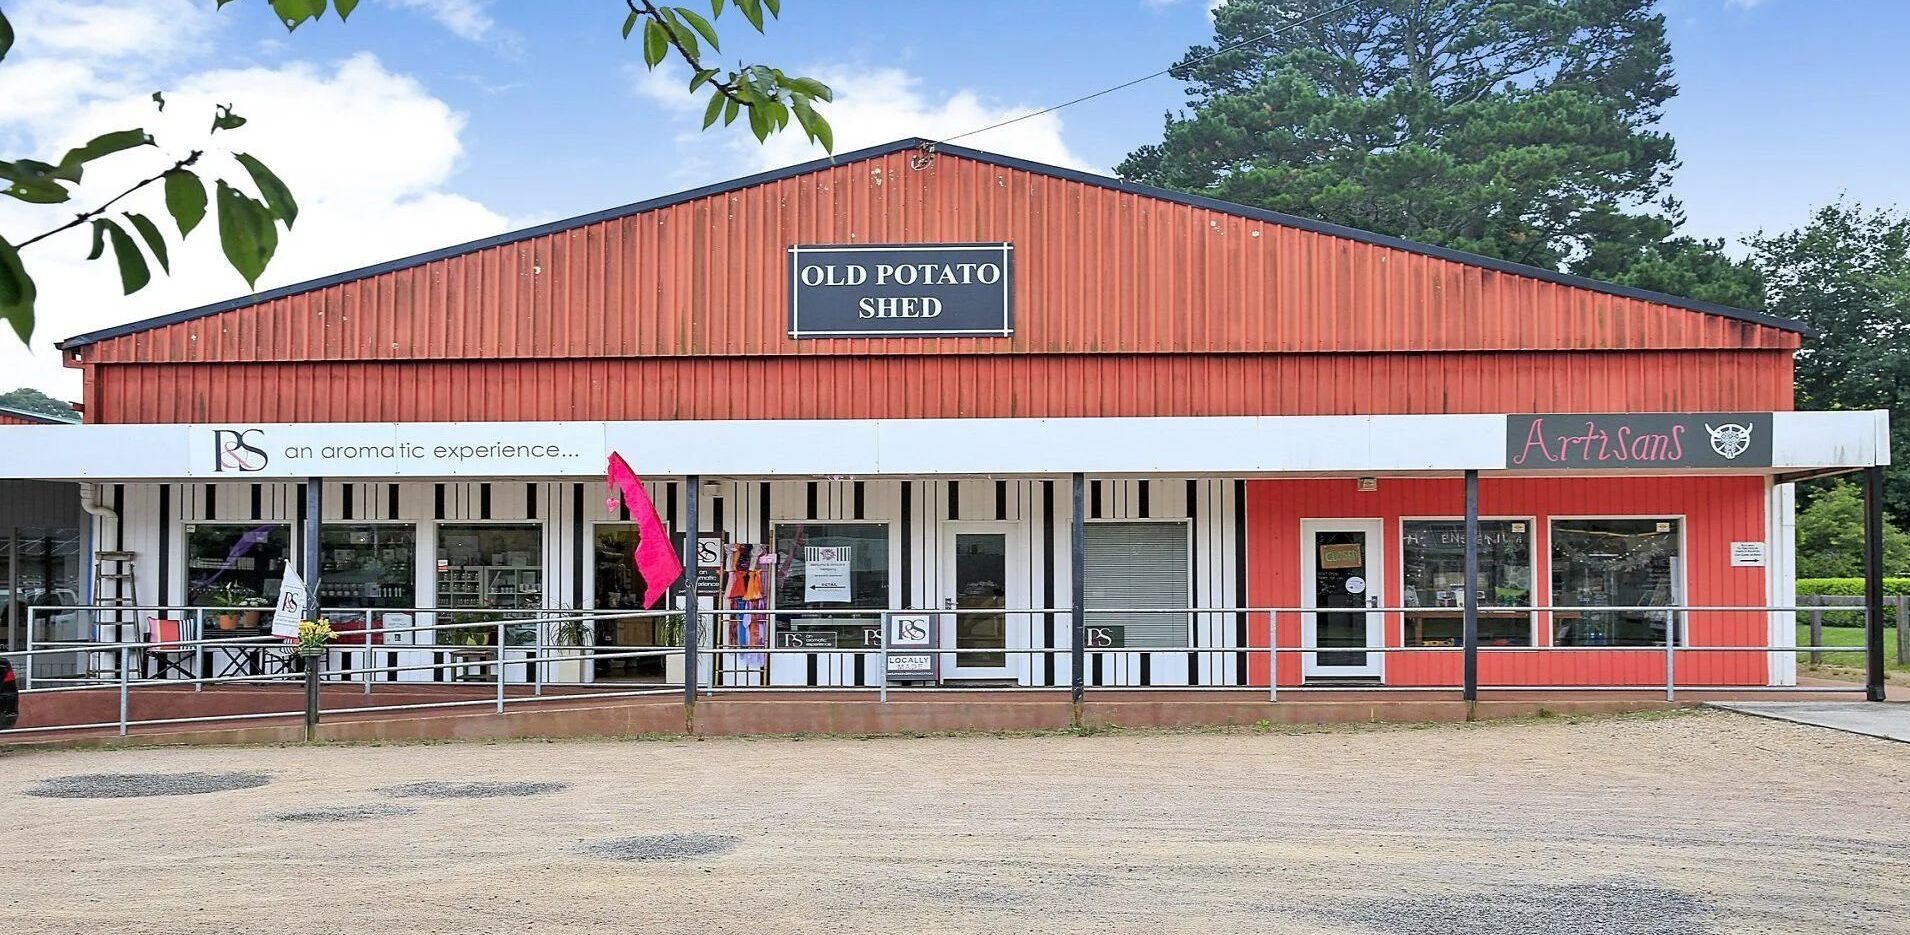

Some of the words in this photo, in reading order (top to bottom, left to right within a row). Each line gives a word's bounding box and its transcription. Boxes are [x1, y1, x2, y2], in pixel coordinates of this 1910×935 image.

[801, 265, 867, 286] OLD
[876, 263, 1000, 285] POTATO
[859, 297, 942, 319] SHED
[284, 446, 313, 459] an
[321, 443, 425, 459] aromatic
[1513, 418, 1686, 465] Artisans
